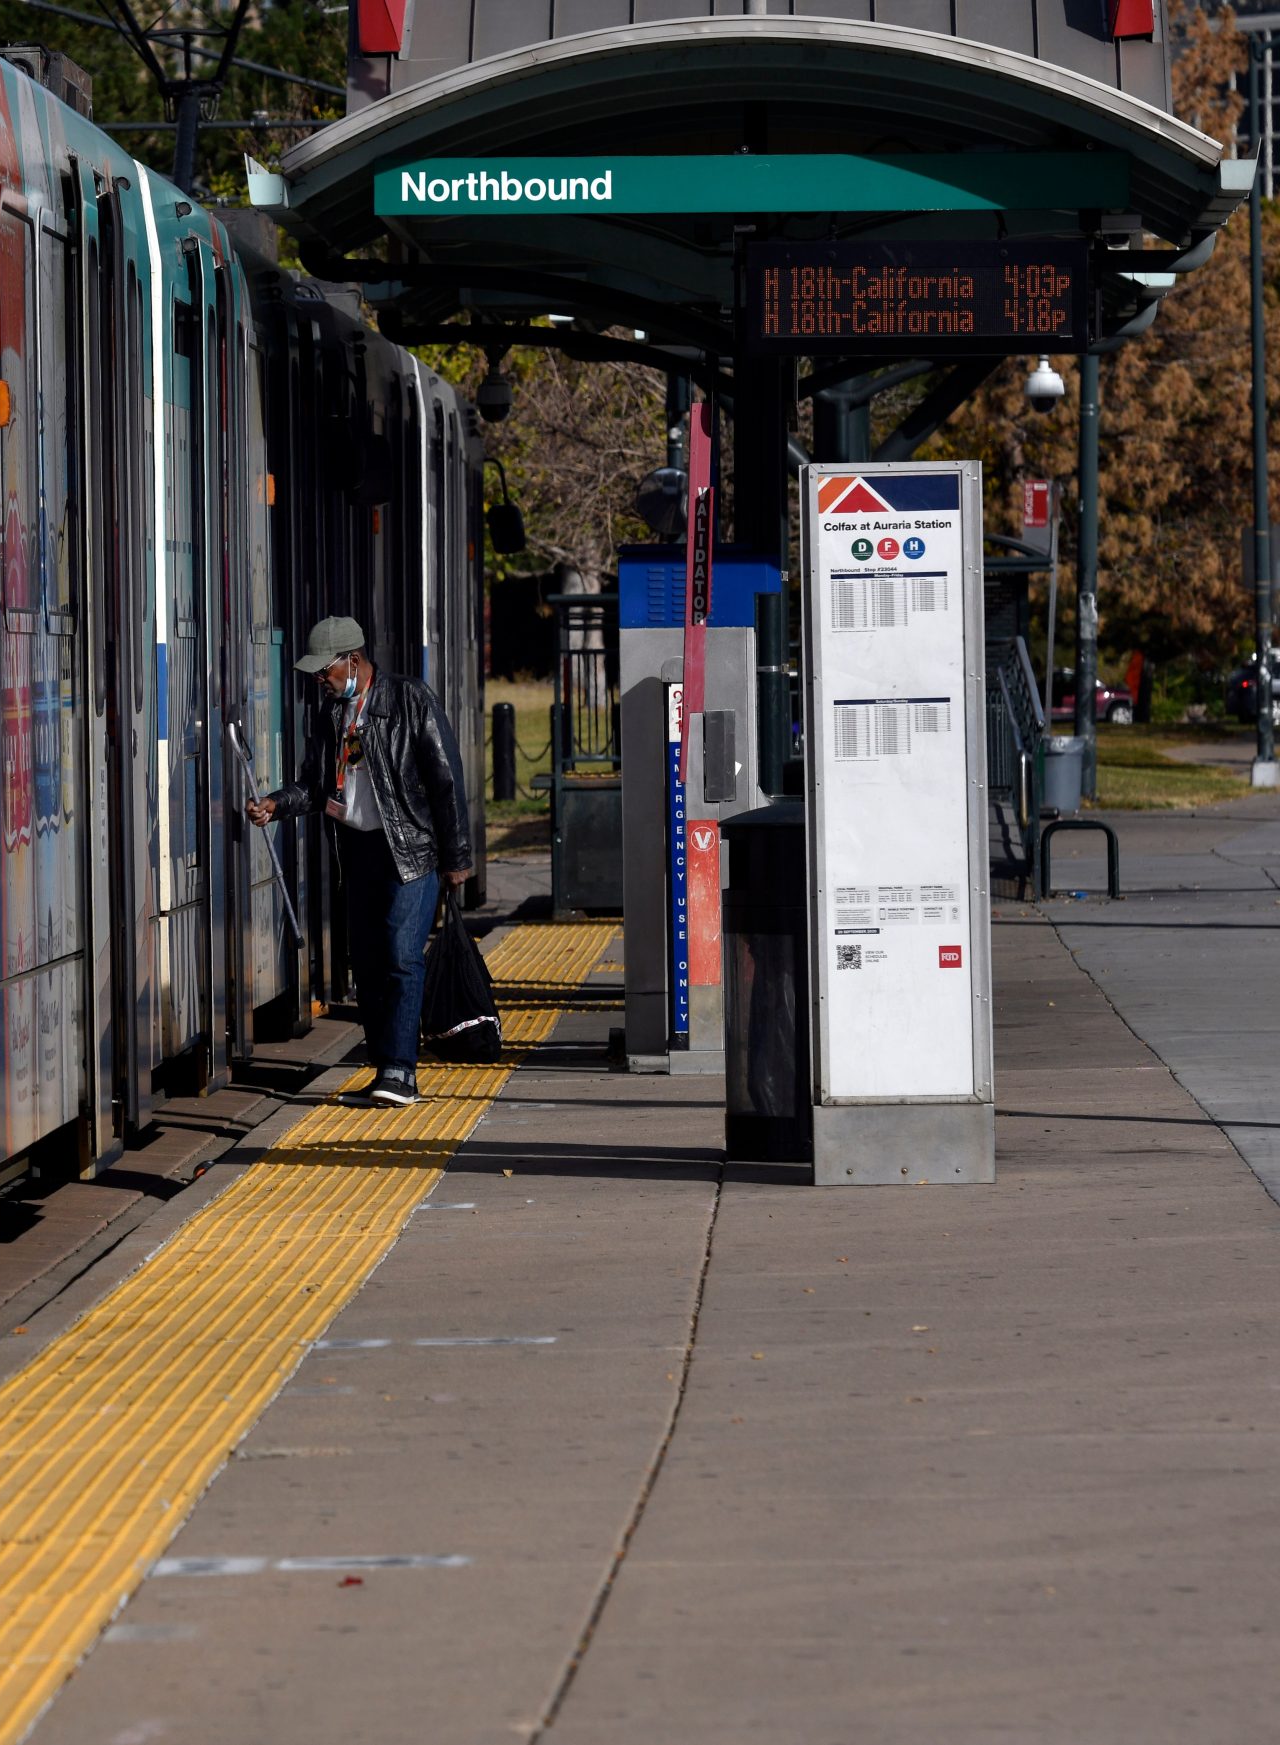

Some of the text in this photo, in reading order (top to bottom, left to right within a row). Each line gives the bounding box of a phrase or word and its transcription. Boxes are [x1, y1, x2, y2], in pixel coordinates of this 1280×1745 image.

[401, 170, 612, 202] Northbound
[765, 264, 1070, 300] H 18th-California 4:03p
[765, 299, 1067, 334] H 18th-California 4:18p
[823, 519, 952, 531] Colfax at Auraria Station
[693, 486, 708, 626] VALIDATOR
[858, 540, 918, 552] D F H
[694, 831, 712, 850] V
[678, 898, 686, 940] USE
[941, 952, 960, 962] RTD
[679, 961, 688, 1022] ONLY
